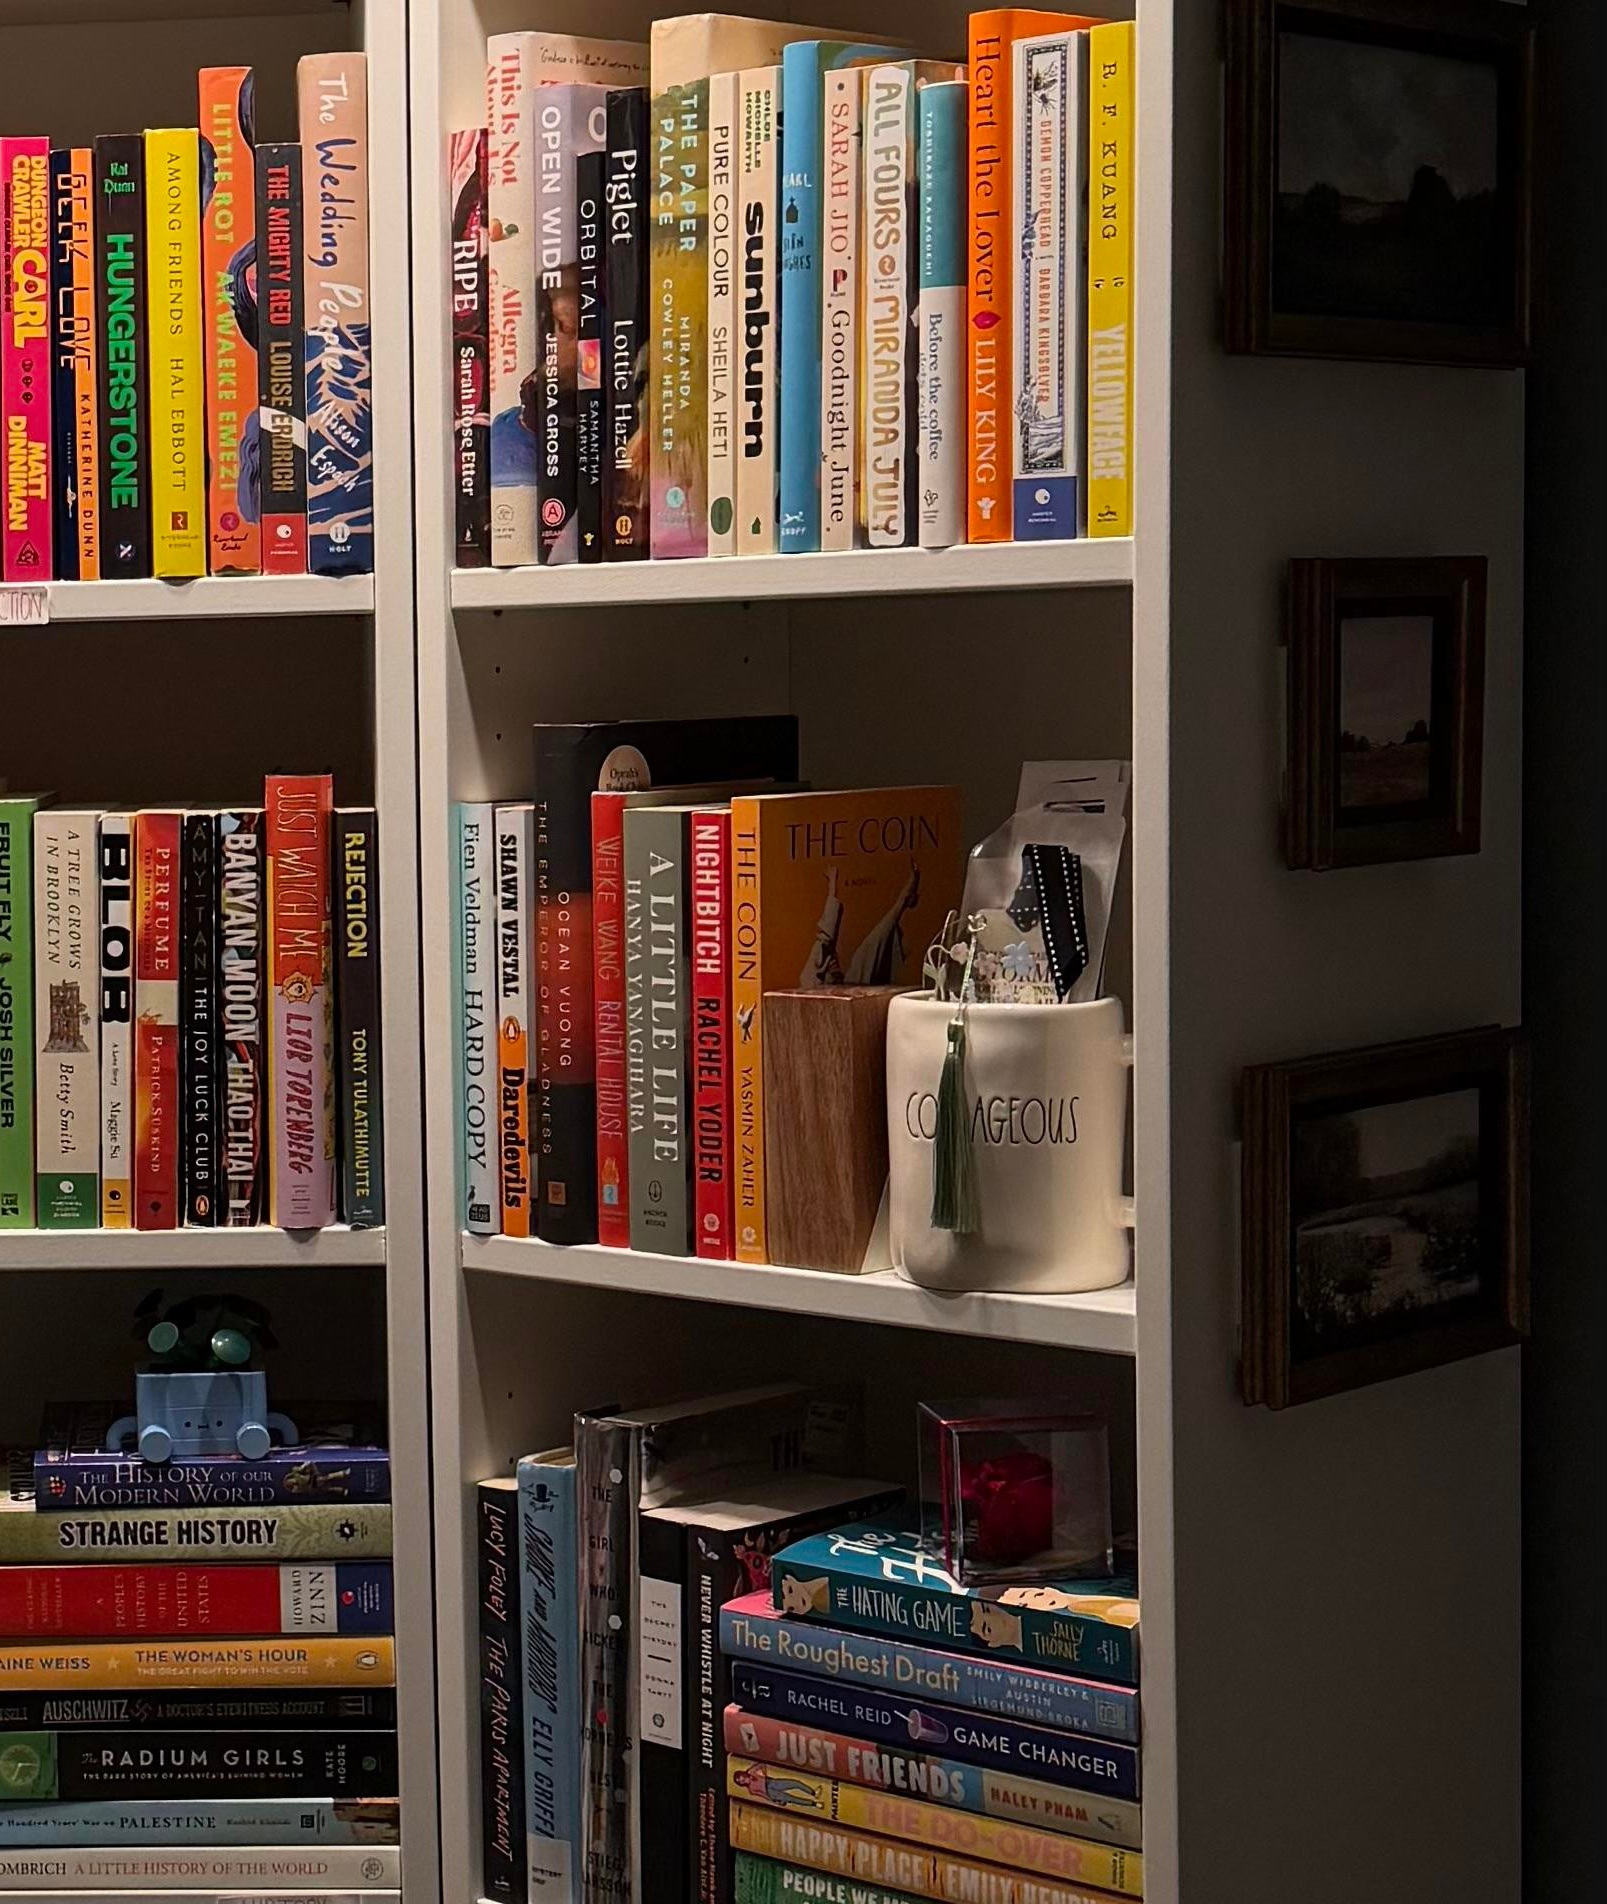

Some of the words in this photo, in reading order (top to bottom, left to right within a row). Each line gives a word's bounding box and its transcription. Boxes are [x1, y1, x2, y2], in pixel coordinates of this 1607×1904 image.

[974, 36, 1001, 136] Heart
[606, 148, 636, 246] Piglet
[975, 144, 1000, 198] the
[581, 199, 596, 329] ORBITAL
[974, 209, 1000, 303] Lover
[106, 233, 138, 508] HUNGERSTONE
[744, 202, 770, 459] Sunburn
[649, 851, 674, 875] A
[784, 823, 845, 859] THE
[858, 815, 940, 855] COIN
[154, 848, 171, 971] PERFUME
[344, 832, 367, 957] REJECTION
[696, 825, 720, 975] NIGHTBITCH
[651, 893, 678, 1050] LITTLE
[653, 1065, 678, 1164] LIFE
[905, 1096, 1079, 1144] COAGEOUS
[59, 1521, 170, 1548] STRANGE
[176, 1518, 278, 1543] HISTORY
[731, 1619, 771, 1653] The
[778, 1628, 890, 1678] Roughest
[894, 1653, 961, 1693] Draft
[102, 1749, 210, 1767] RADIUM
[223, 1749, 304, 1767] GIRLS
[953, 1727, 1012, 1756] GAME
[1019, 1736, 1118, 1780] CHANGER
